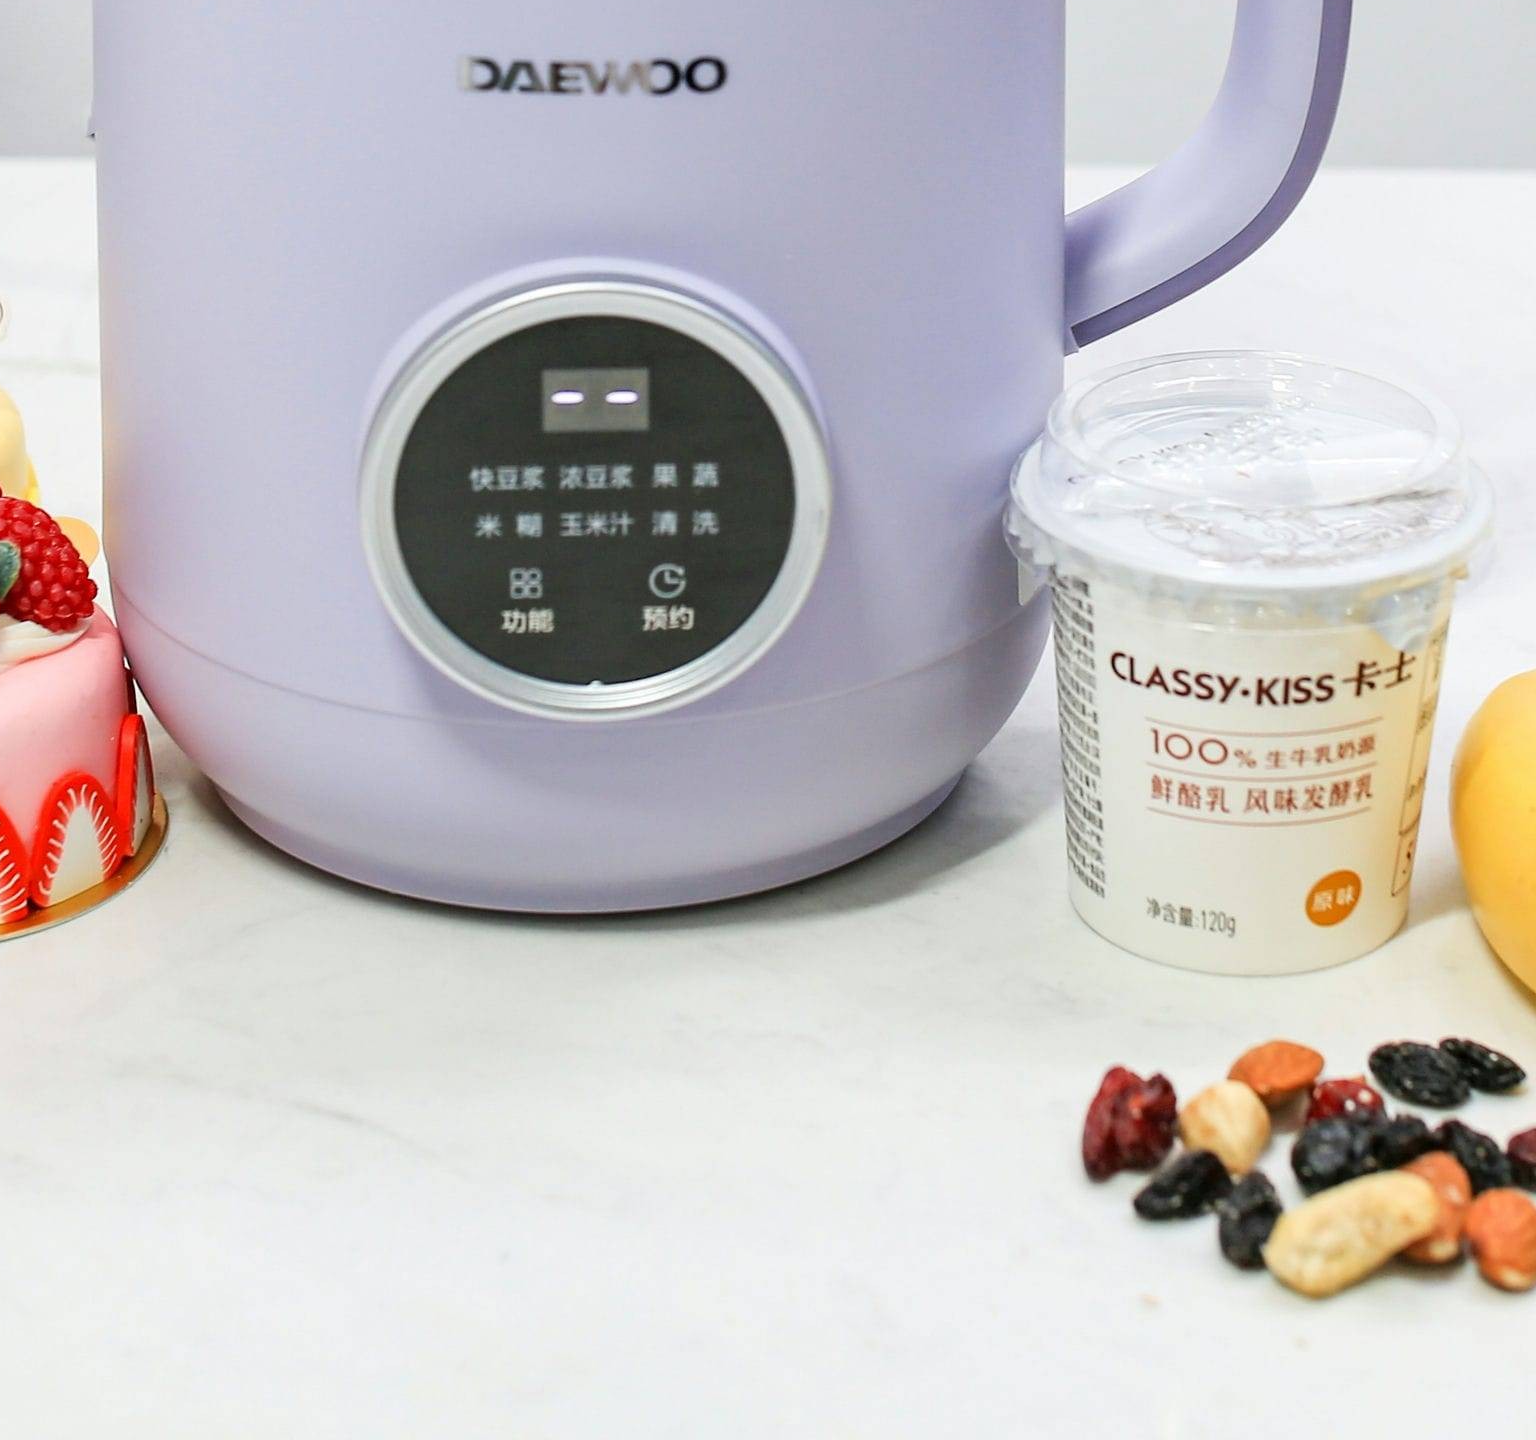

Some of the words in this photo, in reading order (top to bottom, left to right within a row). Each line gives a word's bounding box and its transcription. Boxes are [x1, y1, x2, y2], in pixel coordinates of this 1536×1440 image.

[461, 56, 727, 95] DAEWOO
[470, 465, 545, 492] 快豆浆
[559, 464, 633, 490] 浓豆浆
[559, 511, 635, 537] 玉米汁
[501, 607, 555, 634] 功能
[642, 604, 695, 632] 预约
[1342, 650, 1416, 697] 卡士
[1151, 728, 1257, 768] 100%
[1265, 733, 1376, 769] 生牛乳奶源
[1151, 774, 1229, 813] 鲜酪乳
[1244, 773, 1373, 814] 风味发酵乳
[1312, 885, 1356, 912] 原味
